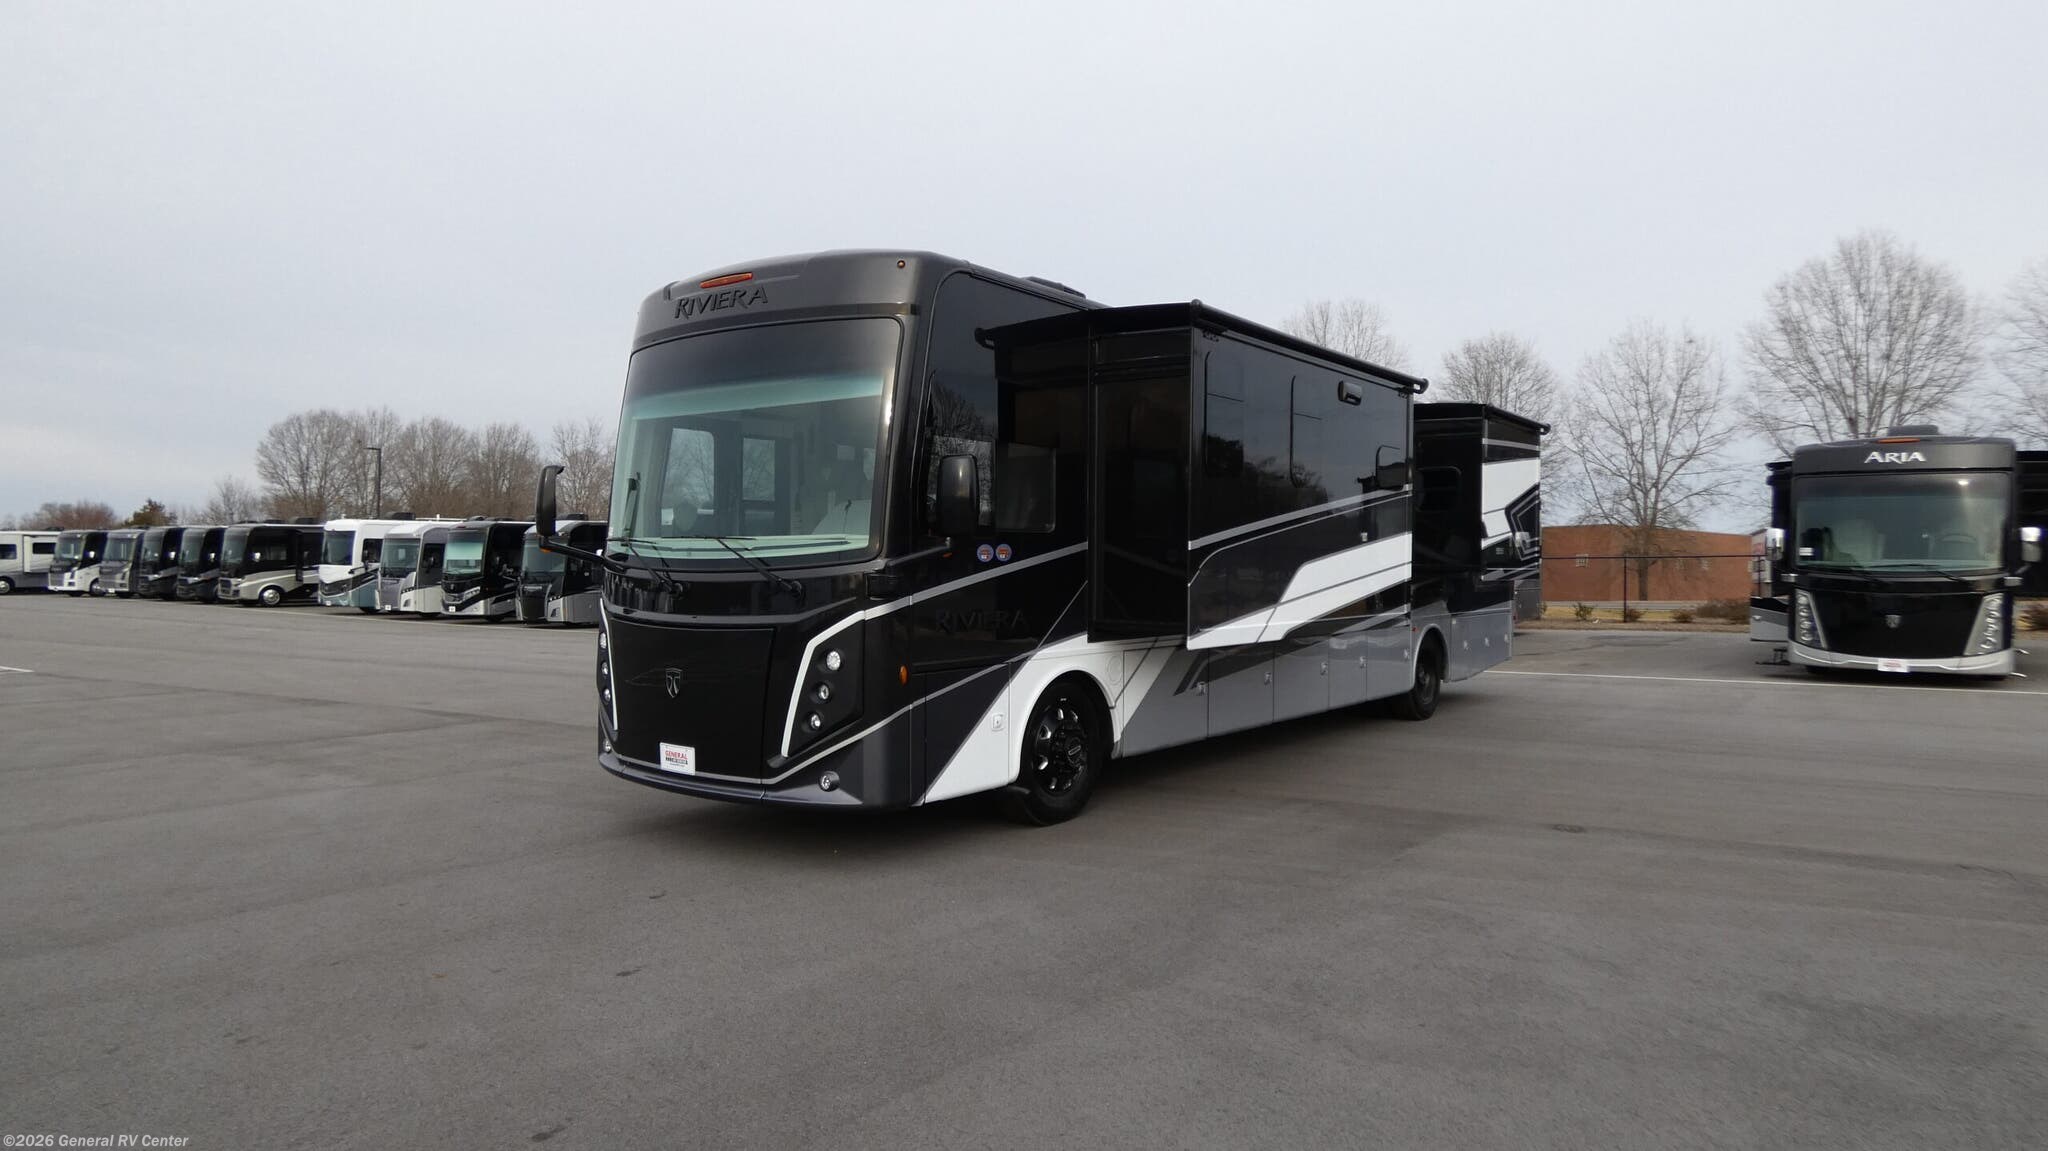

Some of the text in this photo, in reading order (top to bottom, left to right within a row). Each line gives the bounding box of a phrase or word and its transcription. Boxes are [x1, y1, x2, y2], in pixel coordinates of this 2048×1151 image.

[674, 287, 769, 320] RIVIERA
[1864, 451, 1927, 464] ARIA
[935, 607, 1027, 633] RIVIERA
